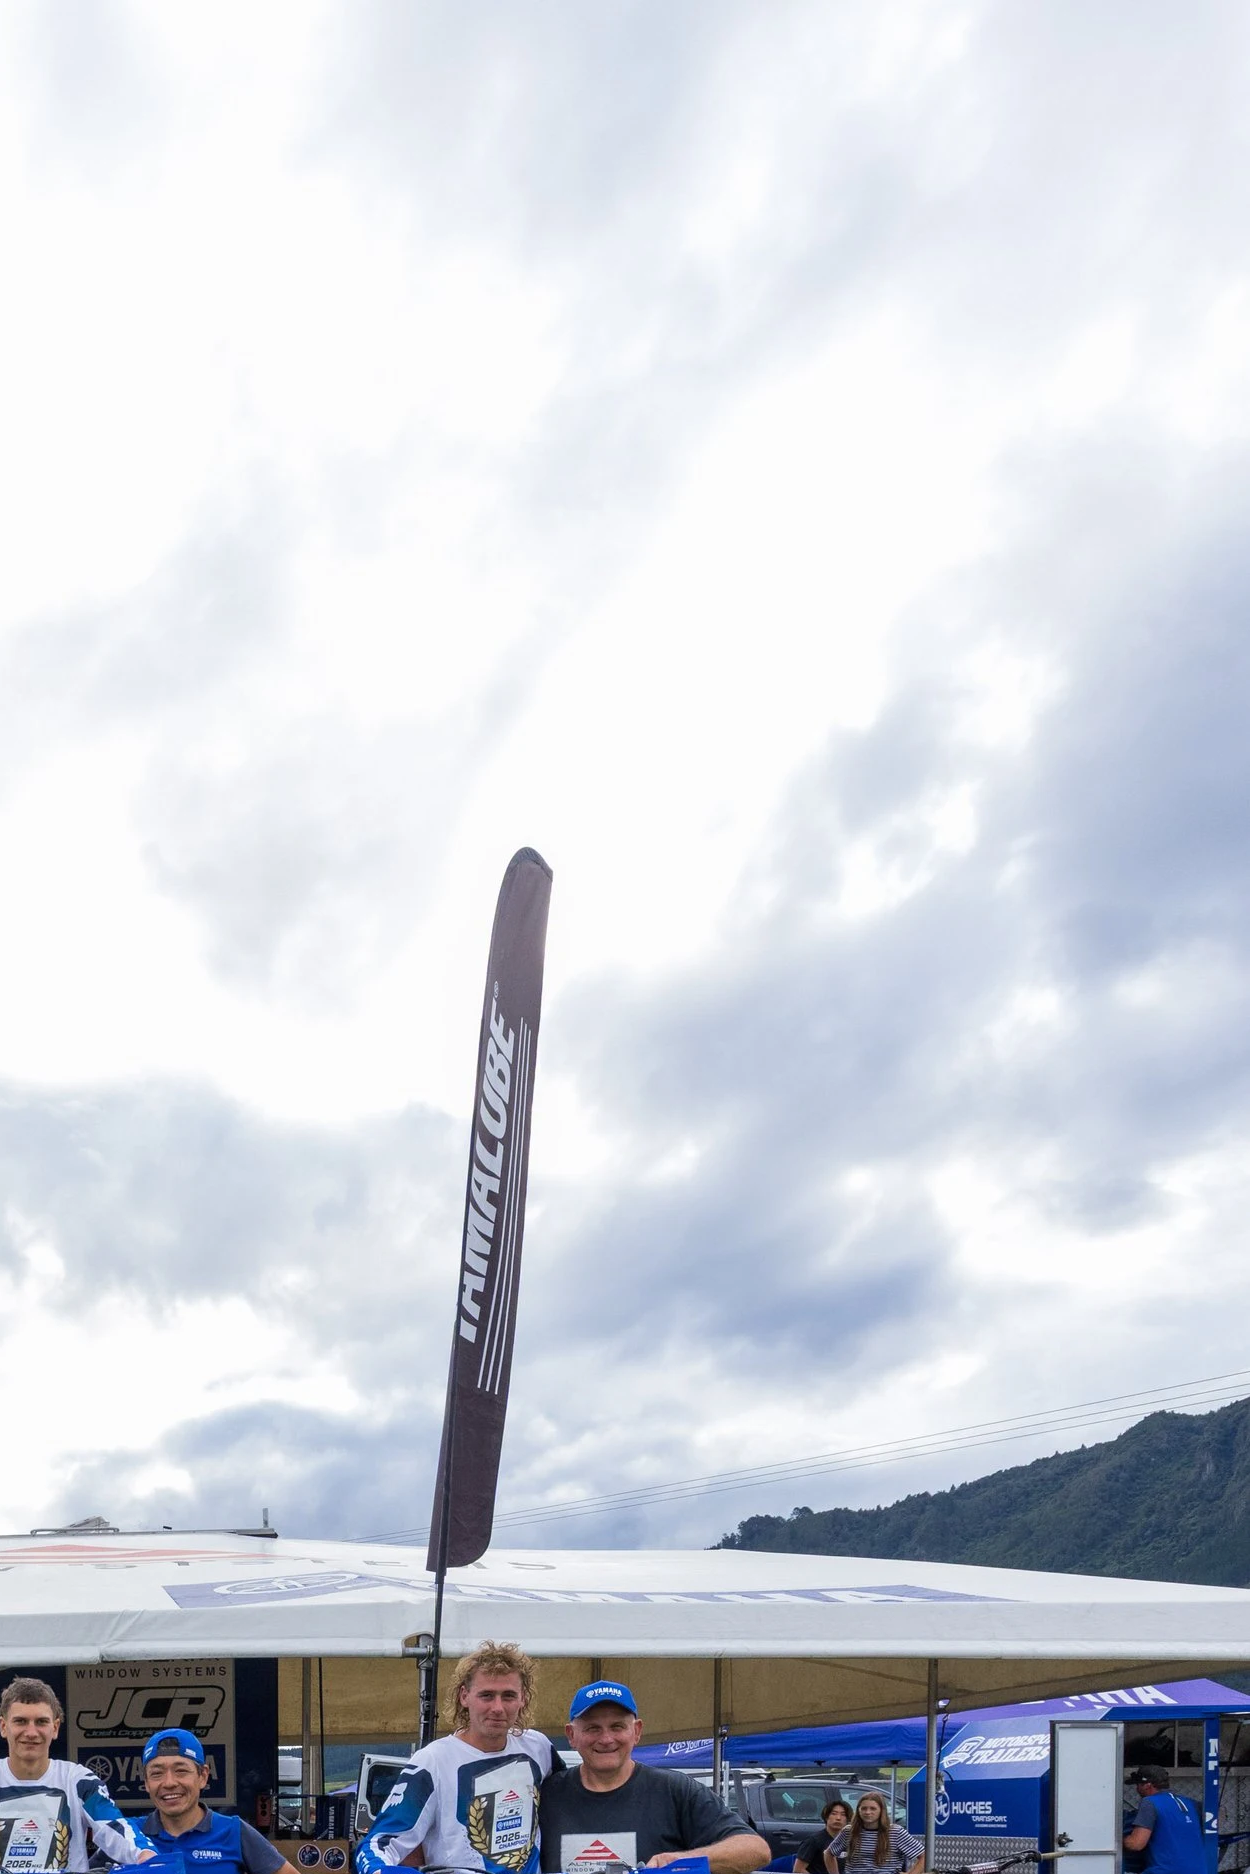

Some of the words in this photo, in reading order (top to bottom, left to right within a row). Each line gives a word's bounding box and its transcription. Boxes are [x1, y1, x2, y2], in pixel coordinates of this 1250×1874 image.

[75, 1668, 141, 1679] WINDOW
[152, 1666, 227, 1678] SYSTEMS
[594, 1687, 622, 1697] YAMAHA
[76, 1685, 226, 1731] JCR
[966, 1746, 1049, 1765] TRAILERS
[952, 1801, 993, 1815] HUGHES
[972, 1815, 1008, 1823] TRANSPORT
[495, 1832, 521, 1845] 2026
[5, 1860, 32, 1868] 2026
